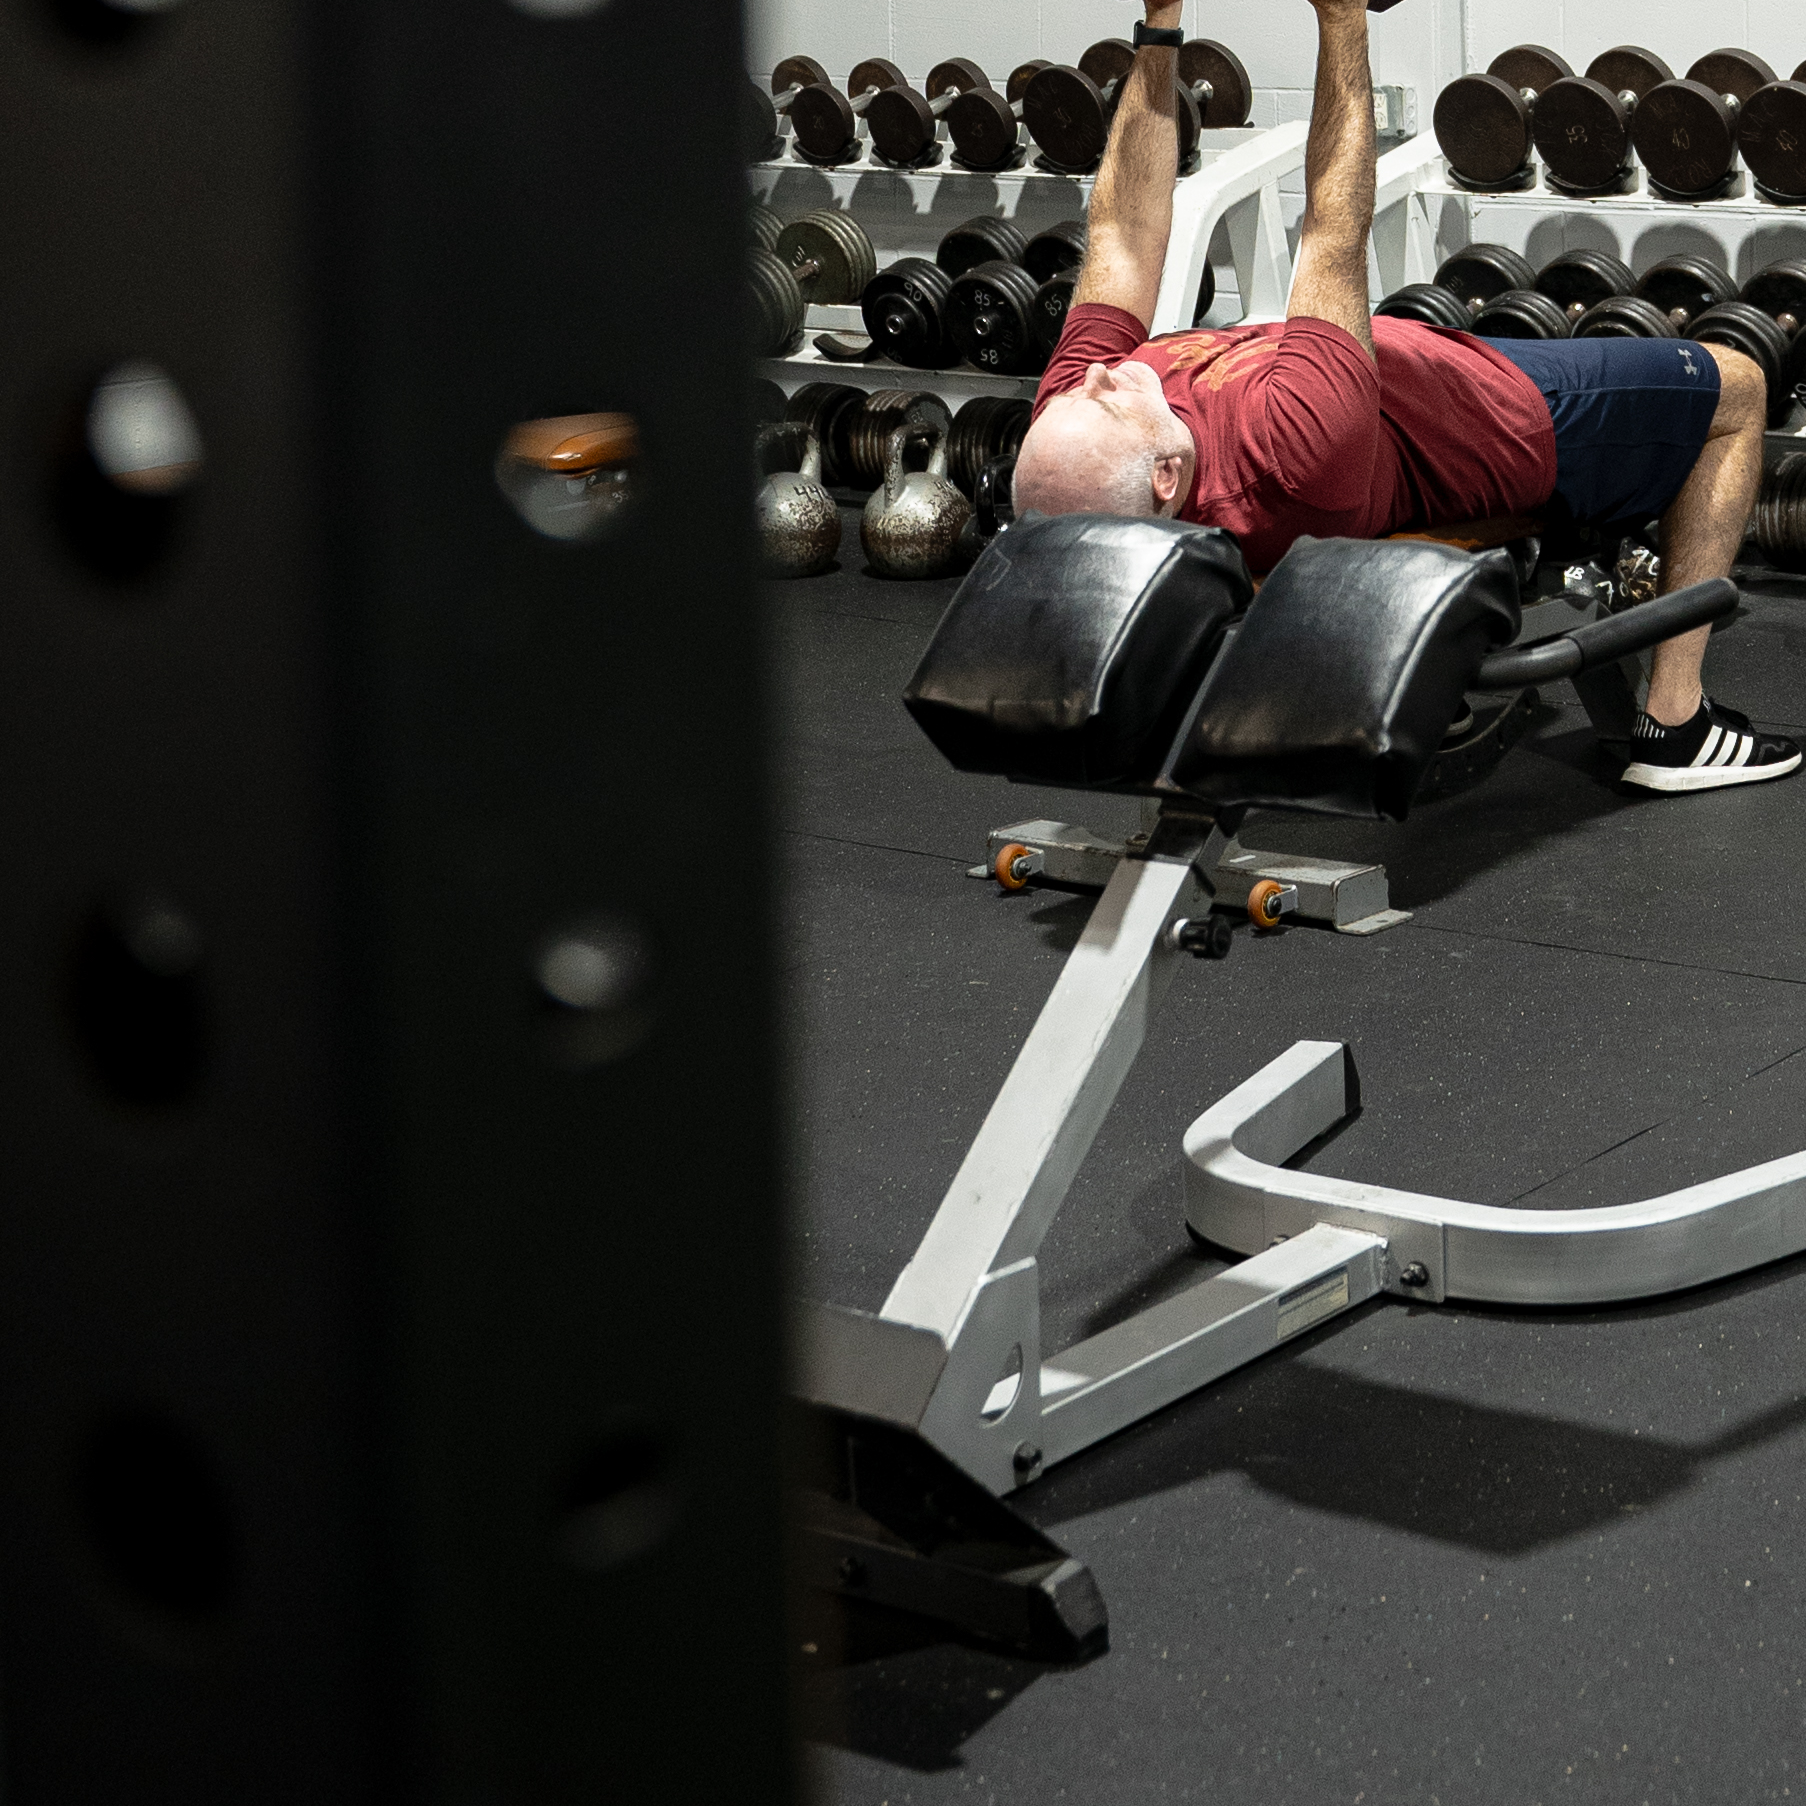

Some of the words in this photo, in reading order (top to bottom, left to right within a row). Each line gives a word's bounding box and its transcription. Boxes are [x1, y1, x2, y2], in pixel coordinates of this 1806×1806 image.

[902, 280, 923, 303] 90
[974, 289, 991, 307] 85
[1044, 293, 1063, 317] 85
[980, 348, 999, 365] 85
